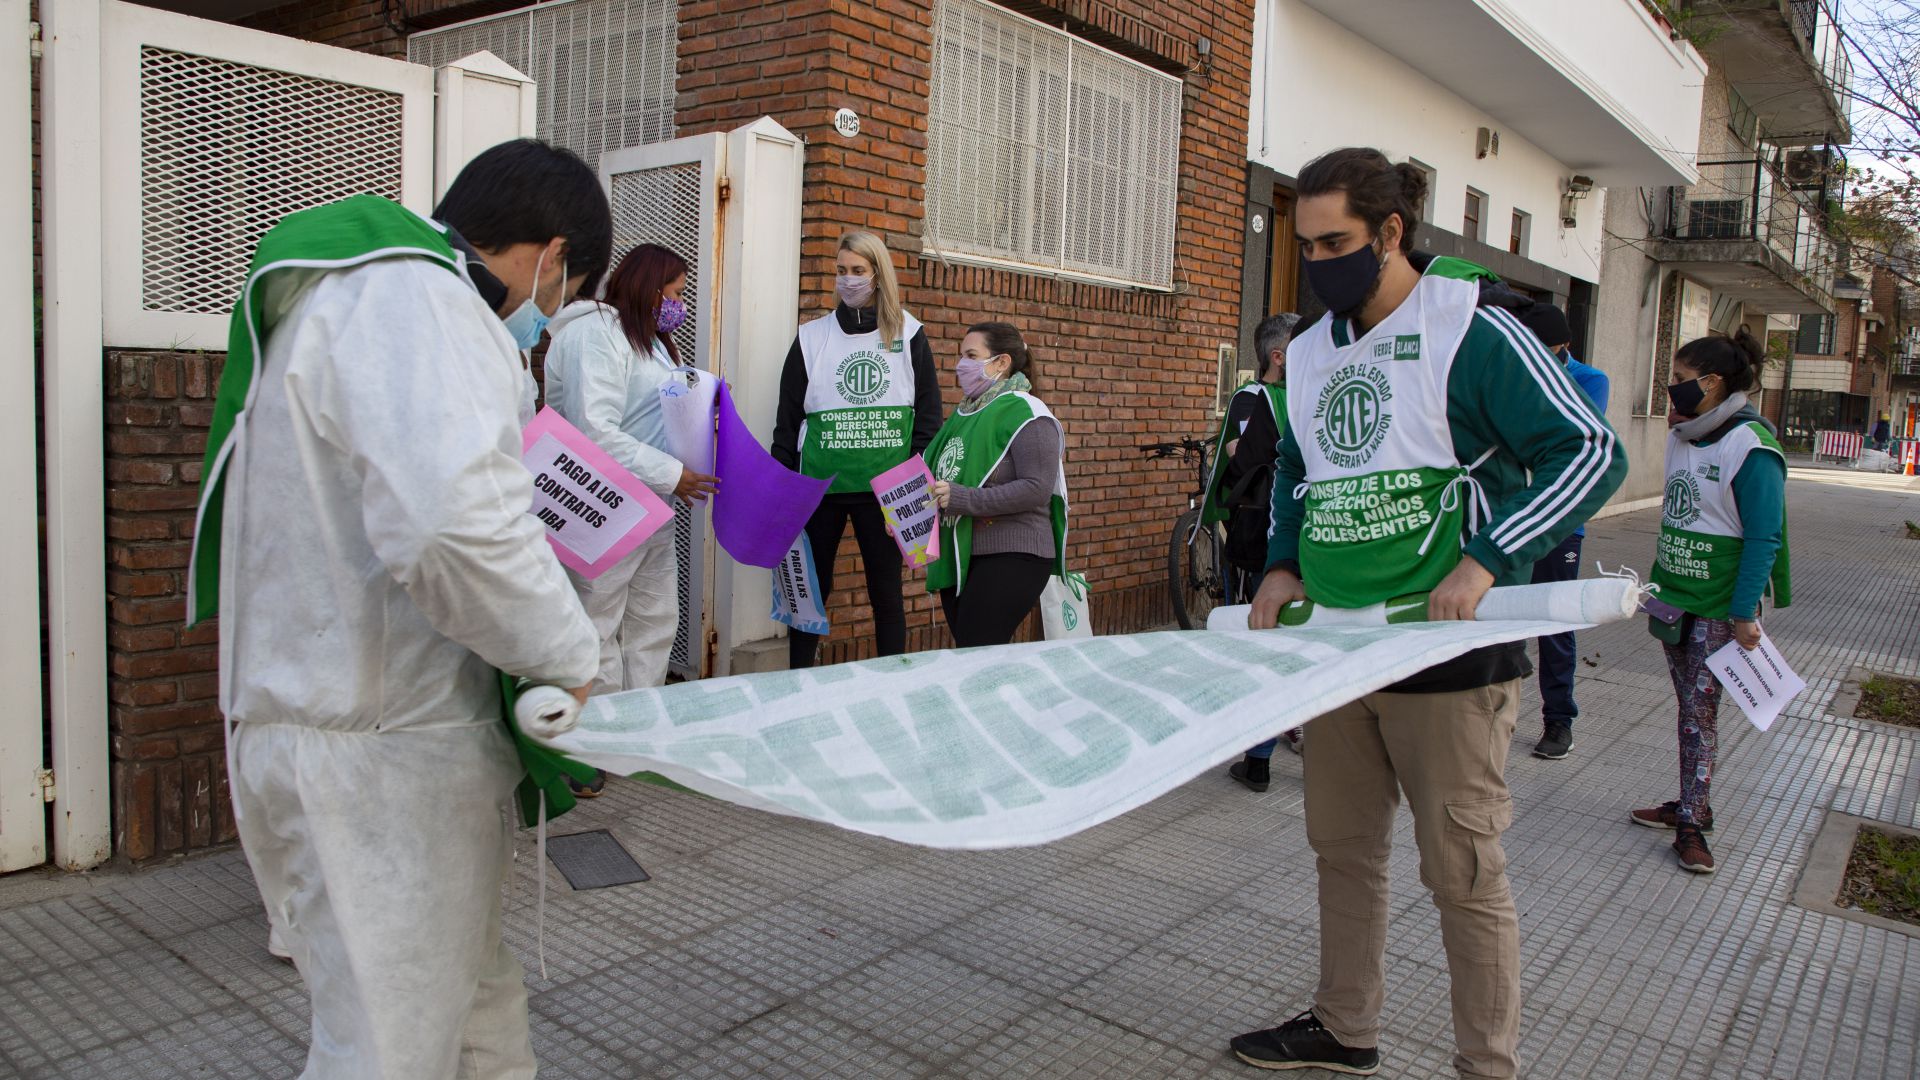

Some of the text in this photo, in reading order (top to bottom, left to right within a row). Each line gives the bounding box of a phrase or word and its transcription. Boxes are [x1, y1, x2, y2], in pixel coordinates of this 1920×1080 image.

[839, 113, 858, 132] 1925
[1373, 340, 1419, 358] VERDE BLANCA
[836, 350, 890, 376] FORTALECER EL ESTADO
[848, 362, 877, 392] ATE
[1356, 363, 1367, 377] EL
[1367, 366, 1393, 402] ESTADO
[835, 381, 846, 397] PARA
[843, 392, 868, 405] LIBERAR
[869, 393, 877, 404] LA
[820, 411, 902, 422] CONSEJO DE LOS
[835, 420, 888, 431] DERECHOS
[1330, 386, 1373, 445] ATE
[820, 438, 903, 449] Y ADOLESCENTES
[822, 431, 833, 440] DE
[872, 427, 901, 439] NIÑOS
[1315, 428, 1330, 455] PARA
[1325, 448, 1361, 469] LIBERAR
[1362, 448, 1372, 465] LA
[553, 453, 624, 510] PAGO A LOS
[1310, 472, 1422, 500] ONSEJO DE LOS
[534, 472, 607, 529] CONTRATOS
[881, 495, 891, 506] NO
[890, 492, 896, 502] A
[894, 485, 907, 499] LOS
[536, 507, 567, 532] UBA
[895, 504, 912, 521] POR
[901, 528, 914, 543] DE
[1674, 536, 1688, 548] DE
[1690, 540, 1713, 552] LOS
[781, 558, 798, 614] TRIBUTISTAS
[790, 549, 802, 574] PAGO
[796, 583, 808, 598] LXS
[1736, 646, 1774, 698] MONOTRIBUTISTAS
[1724, 666, 1758, 708] PAGO A LXS
